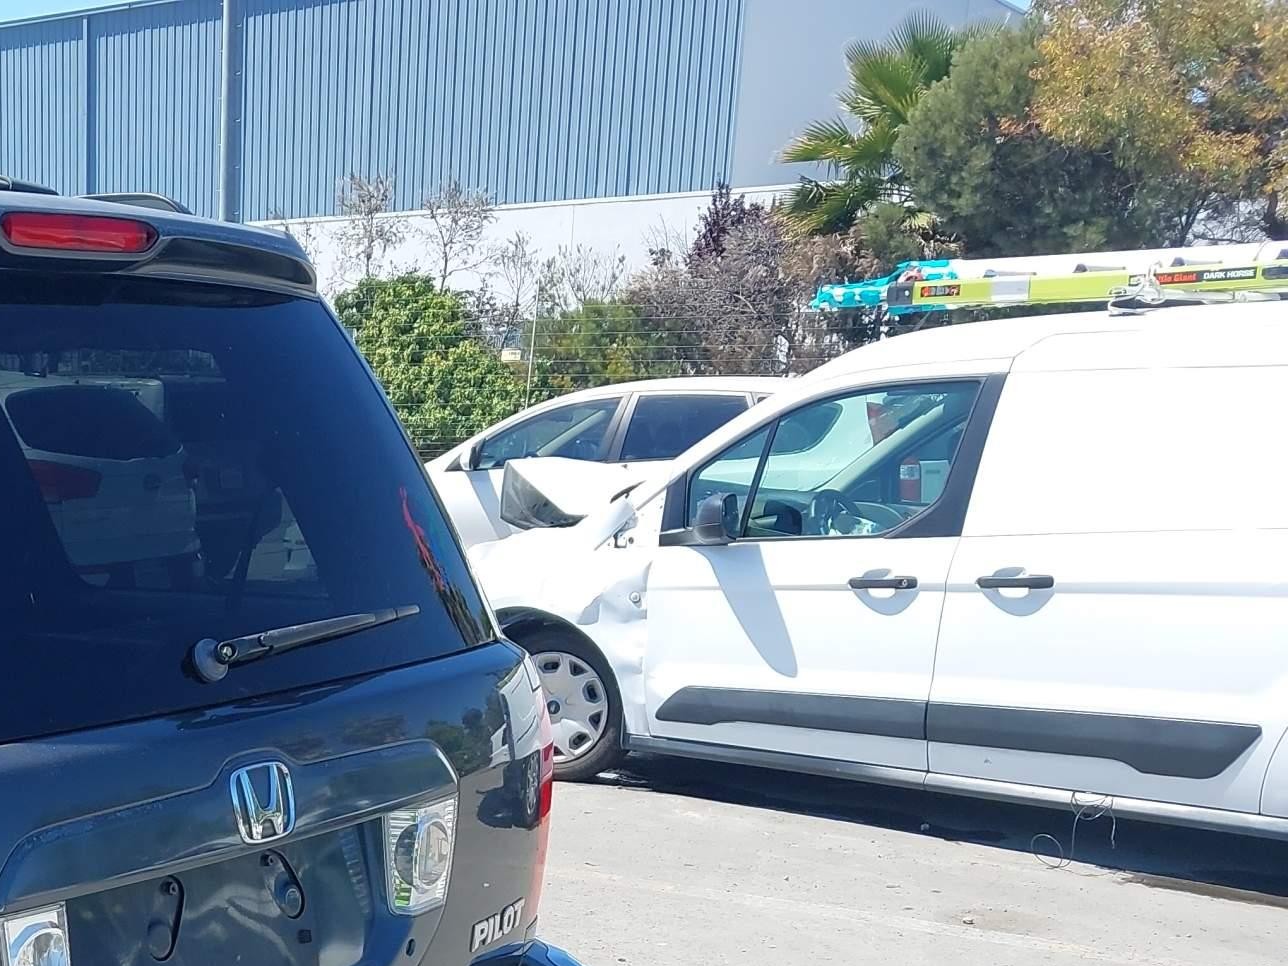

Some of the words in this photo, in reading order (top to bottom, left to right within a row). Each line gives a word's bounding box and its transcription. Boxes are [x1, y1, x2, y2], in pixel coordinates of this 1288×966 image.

[1203, 271, 1226, 280] DARK
[1226, 268, 1256, 279] HORSE
[469, 896, 526, 953] PILOT
